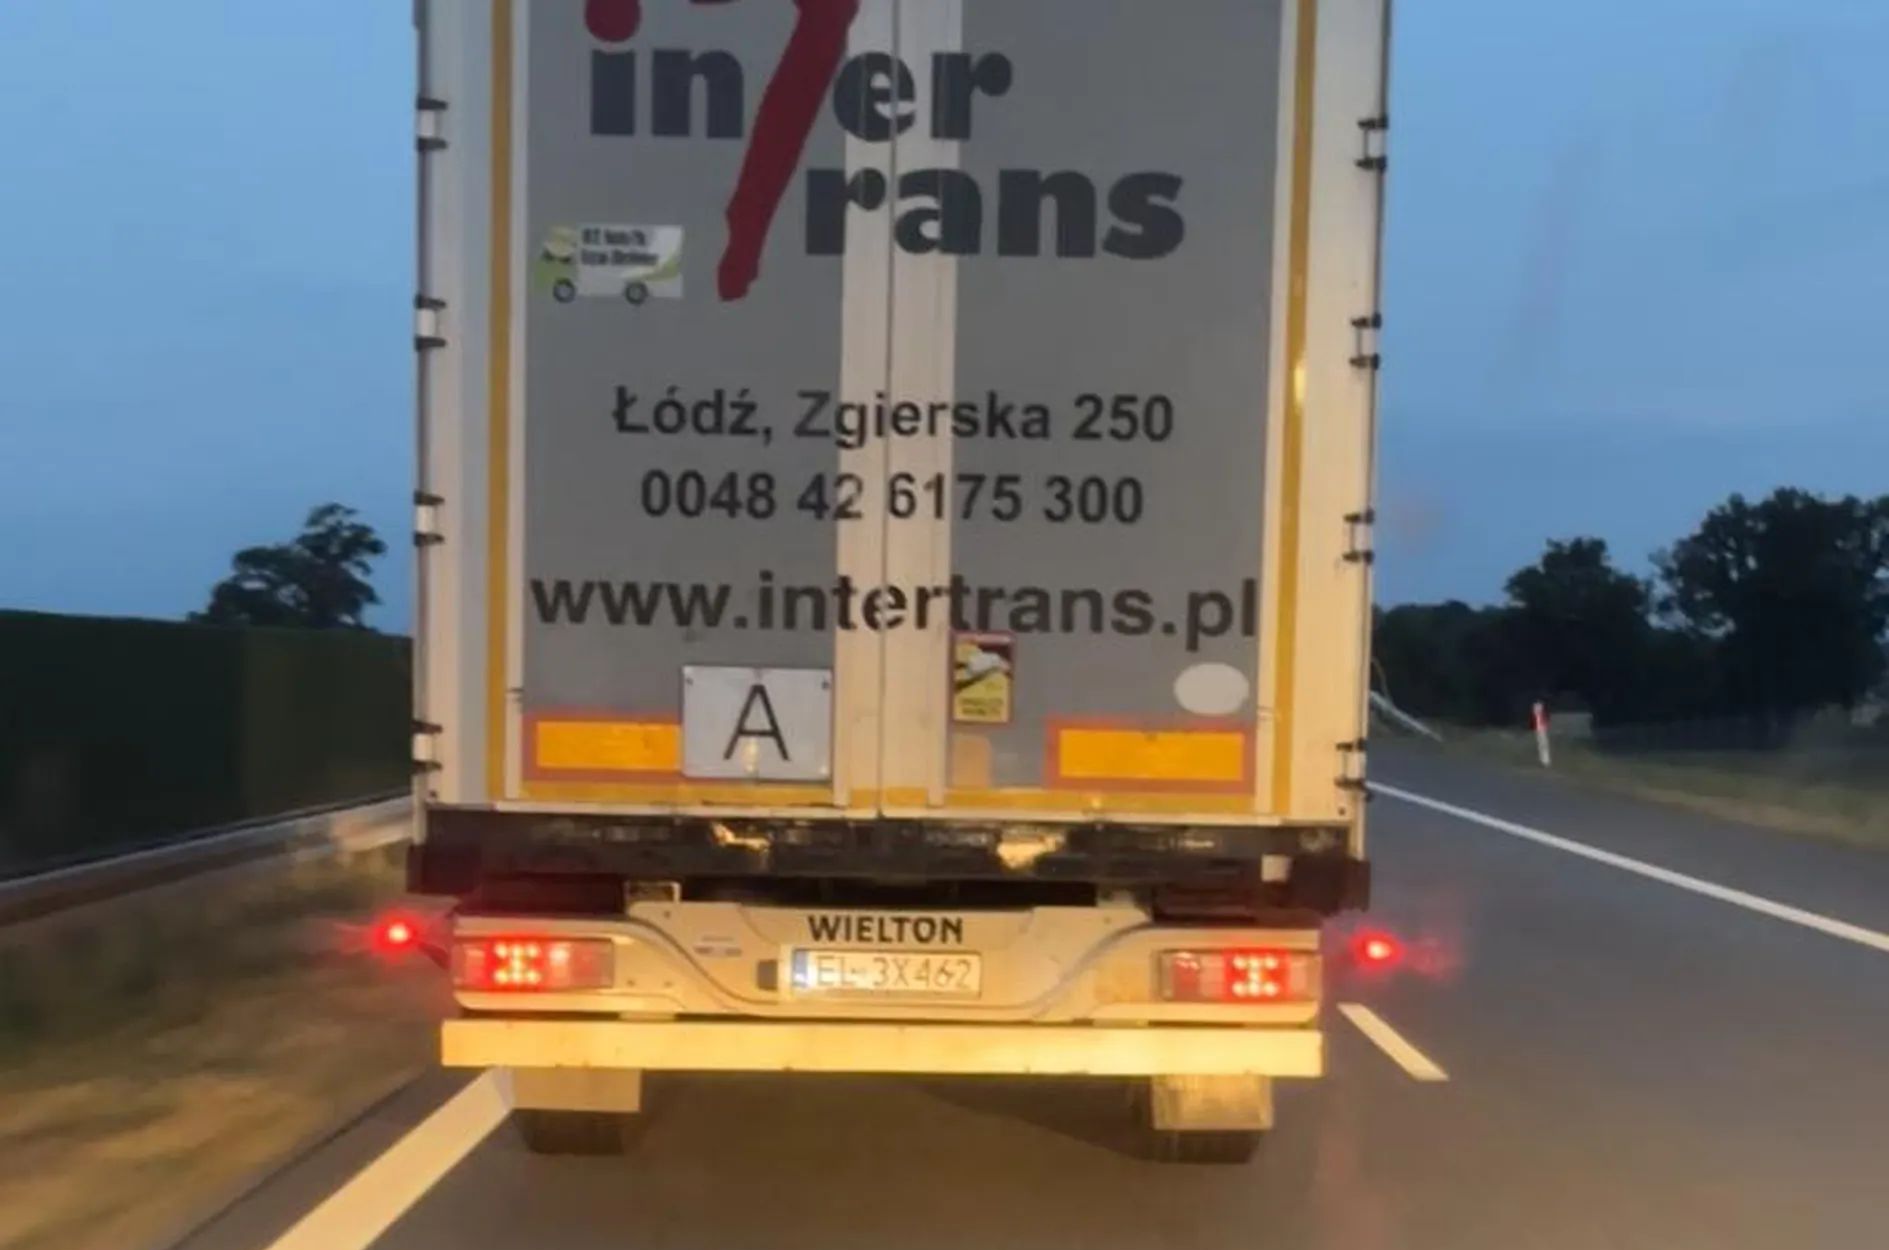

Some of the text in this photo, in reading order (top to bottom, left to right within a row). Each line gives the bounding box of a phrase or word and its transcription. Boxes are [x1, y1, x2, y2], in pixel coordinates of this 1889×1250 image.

[611, 384, 1175, 448] Łódź, Zgierska 250
[639, 468, 1145, 524] 0048 42 6175 300
[529, 569, 1260, 653] www.intertrans.pl
[723, 683, 791, 762] A
[806, 913, 965, 945] WIELTON
[816, 954, 974, 991] EL 3X462
